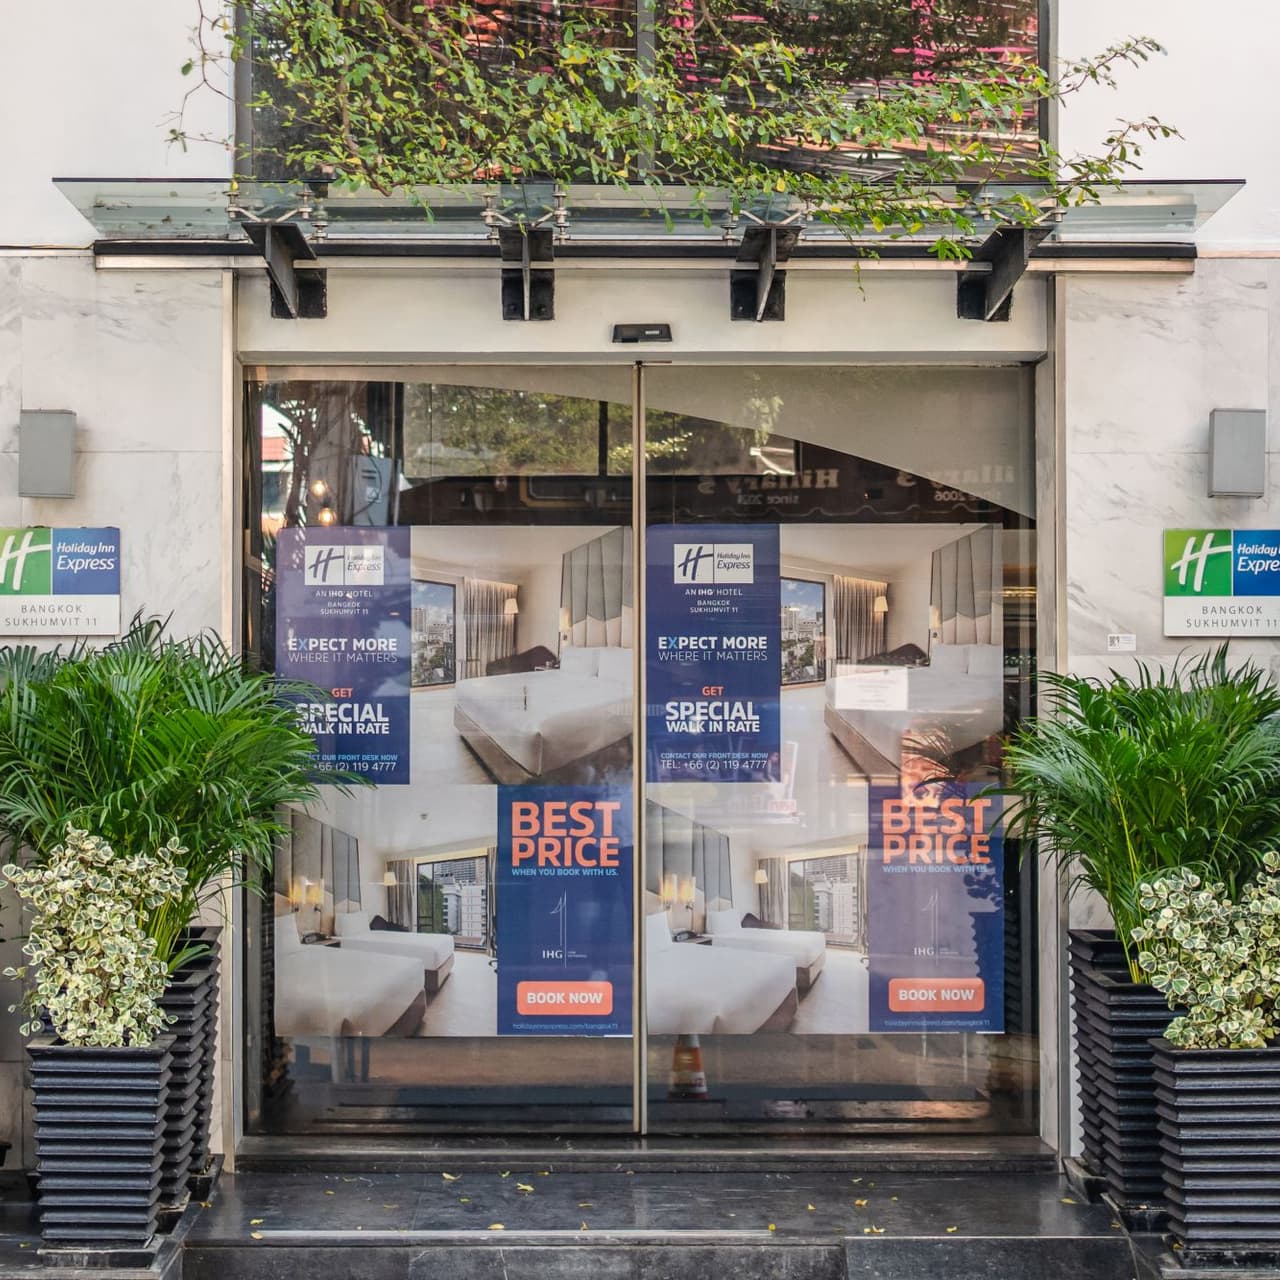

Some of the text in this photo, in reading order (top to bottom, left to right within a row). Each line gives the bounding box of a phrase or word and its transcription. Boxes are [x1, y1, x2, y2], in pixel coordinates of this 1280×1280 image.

[57, 542, 115, 555] Holiday Inn
[1237, 544, 1277, 556] Holiday
[57, 556, 115, 573] Express
[717, 560, 751, 571] Express
[21, 605, 82, 613] BANGKOK
[1202, 606, 1263, 614] BANGKOK
[5, 618, 97, 626] SUKHUMVIT 11
[1186, 619, 1277, 628] SUKHUMVIT 11
[288, 638, 397, 651] EXPECT MORE
[658, 636, 767, 649] EXPECT MORE
[288, 653, 397, 663] WHERE IT MATTERS
[658, 650, 767, 661] WHERE IT MATTERS
[331, 688, 353, 698] GET
[702, 686, 724, 696] GET
[296, 703, 389, 722] SPECIAL
[665, 702, 759, 721] SPECIAL
[339, 723, 353, 734] IN
[356, 723, 389, 734] RATE
[666, 721, 760, 733] WALK IN RATE
[336, 762, 349, 771] (2)
[353, 763, 368, 771] 119
[372, 763, 396, 771] 4777
[661, 760, 767, 770] TEL: +66 (2) 119 4777
[511, 801, 621, 837] BEST
[882, 798, 991, 835] BEST
[511, 837, 620, 867] PRICE
[883, 834, 990, 865] PRICE
[511, 868, 537, 876] WHEN
[538, 868, 555, 876] YOU
[557, 868, 580, 876] BOOK
[582, 868, 604, 876] WITH
[542, 950, 563, 959] IHG
[914, 947, 934, 956] IHG
[527, 992, 603, 1003] BOOK NOW
[899, 989, 974, 1001] BOOK NOW
